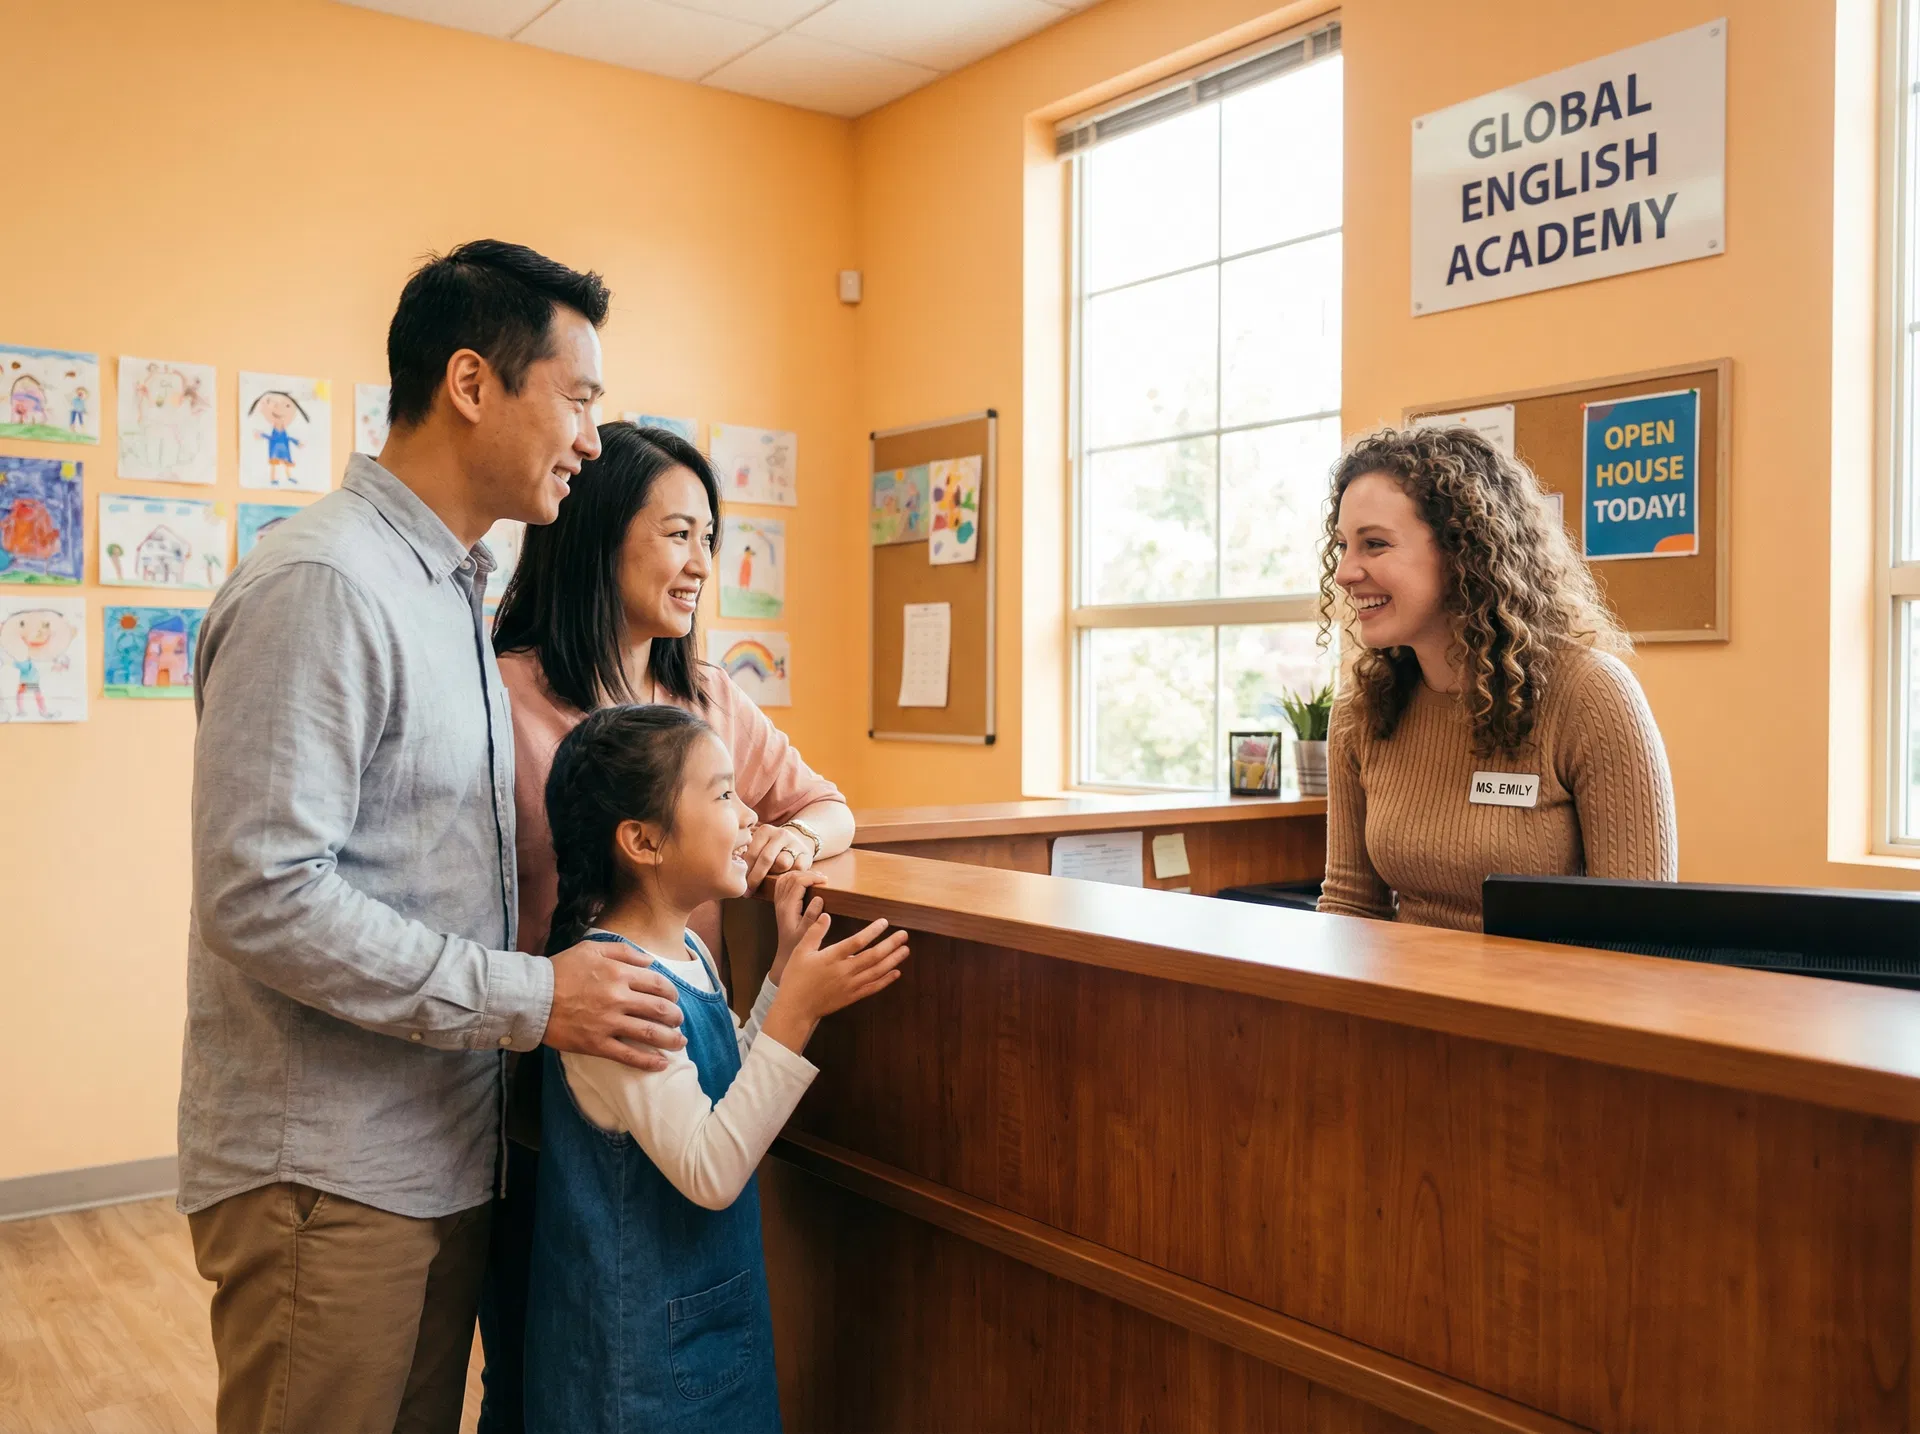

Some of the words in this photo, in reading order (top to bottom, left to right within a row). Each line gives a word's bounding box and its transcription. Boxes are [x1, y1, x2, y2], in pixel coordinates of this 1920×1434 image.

[1468, 73, 1652, 159] GLOBAL
[1461, 132, 1658, 223] ENGLISH
[1445, 192, 1679, 286] ACADEMY
[1604, 419, 1675, 451] OPEN
[1595, 455, 1684, 488] HOUSE
[1593, 493, 1686, 524] TODAY!
[1476, 782, 1495, 794] MS.
[1498, 783, 1533, 796] EMILY
